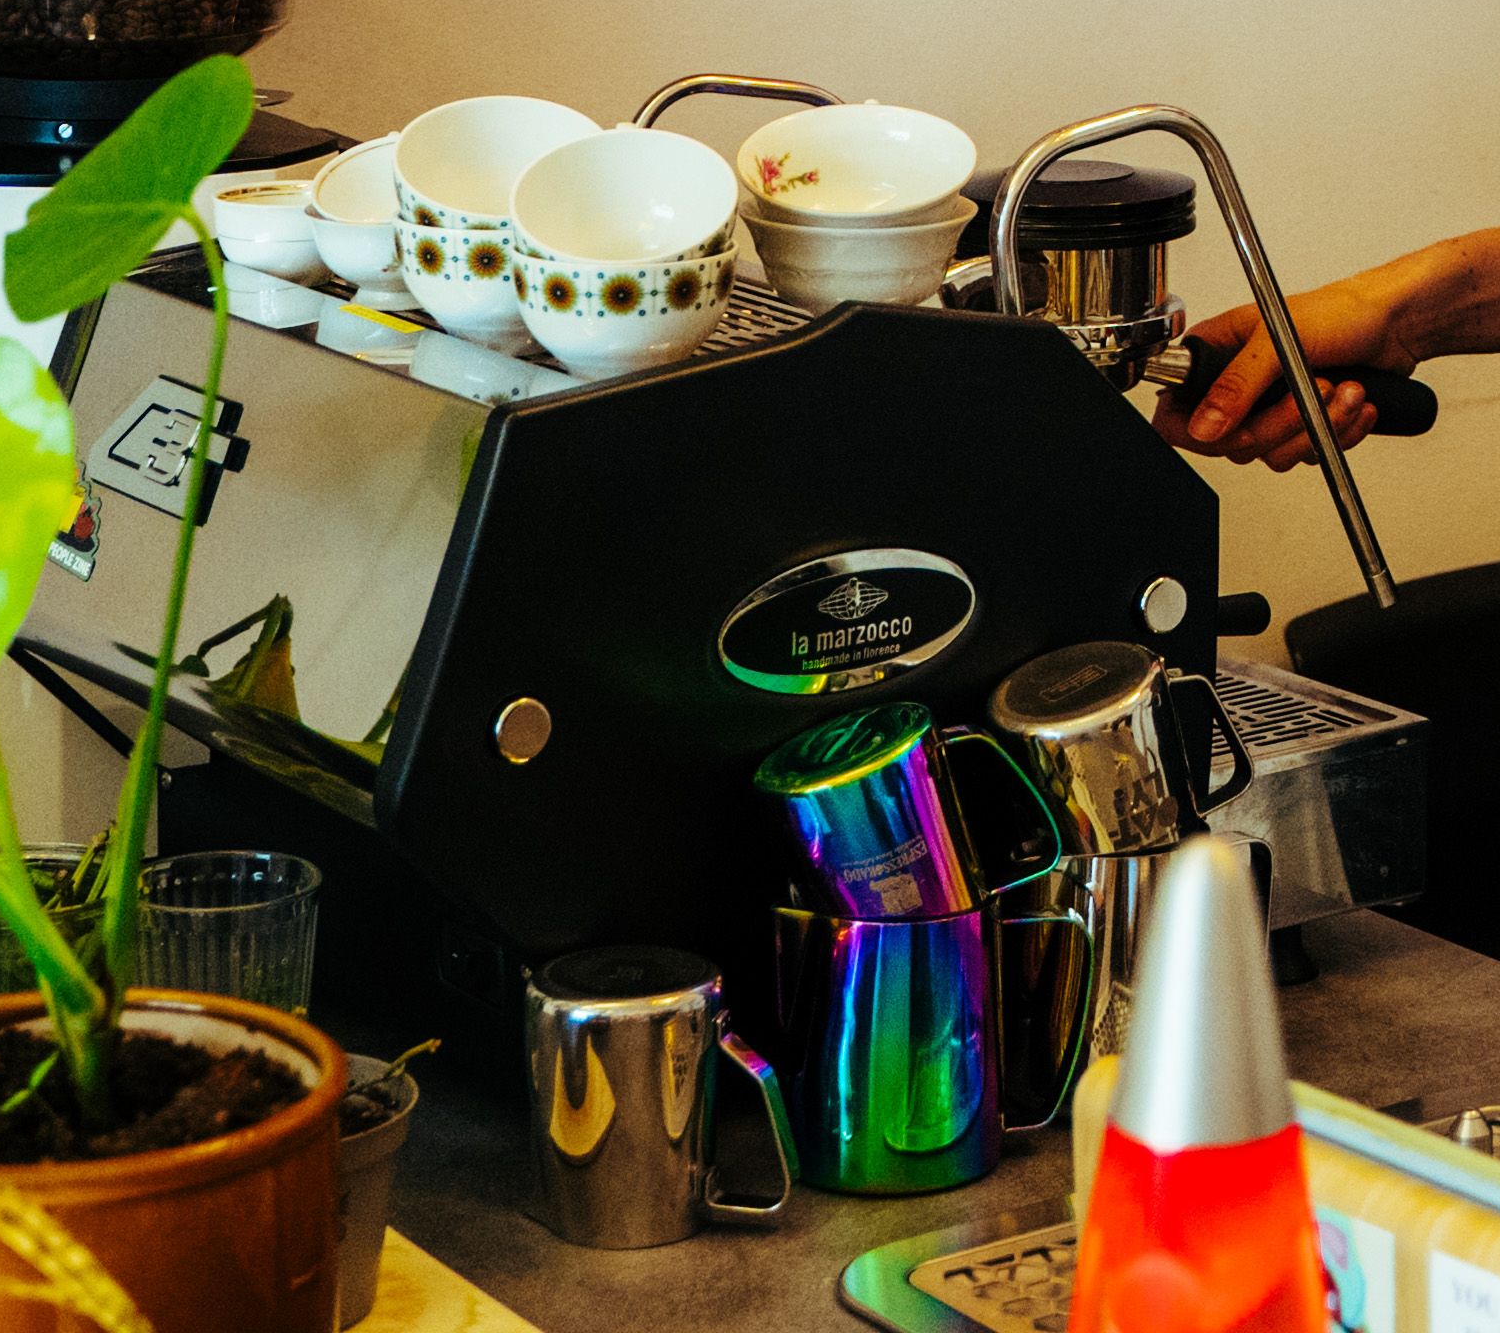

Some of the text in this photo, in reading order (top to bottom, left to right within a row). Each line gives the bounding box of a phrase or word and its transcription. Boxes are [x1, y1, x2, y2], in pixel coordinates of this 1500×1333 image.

[791, 615, 913, 657] la marzocco
[802, 643, 901, 671] handmade in florence
